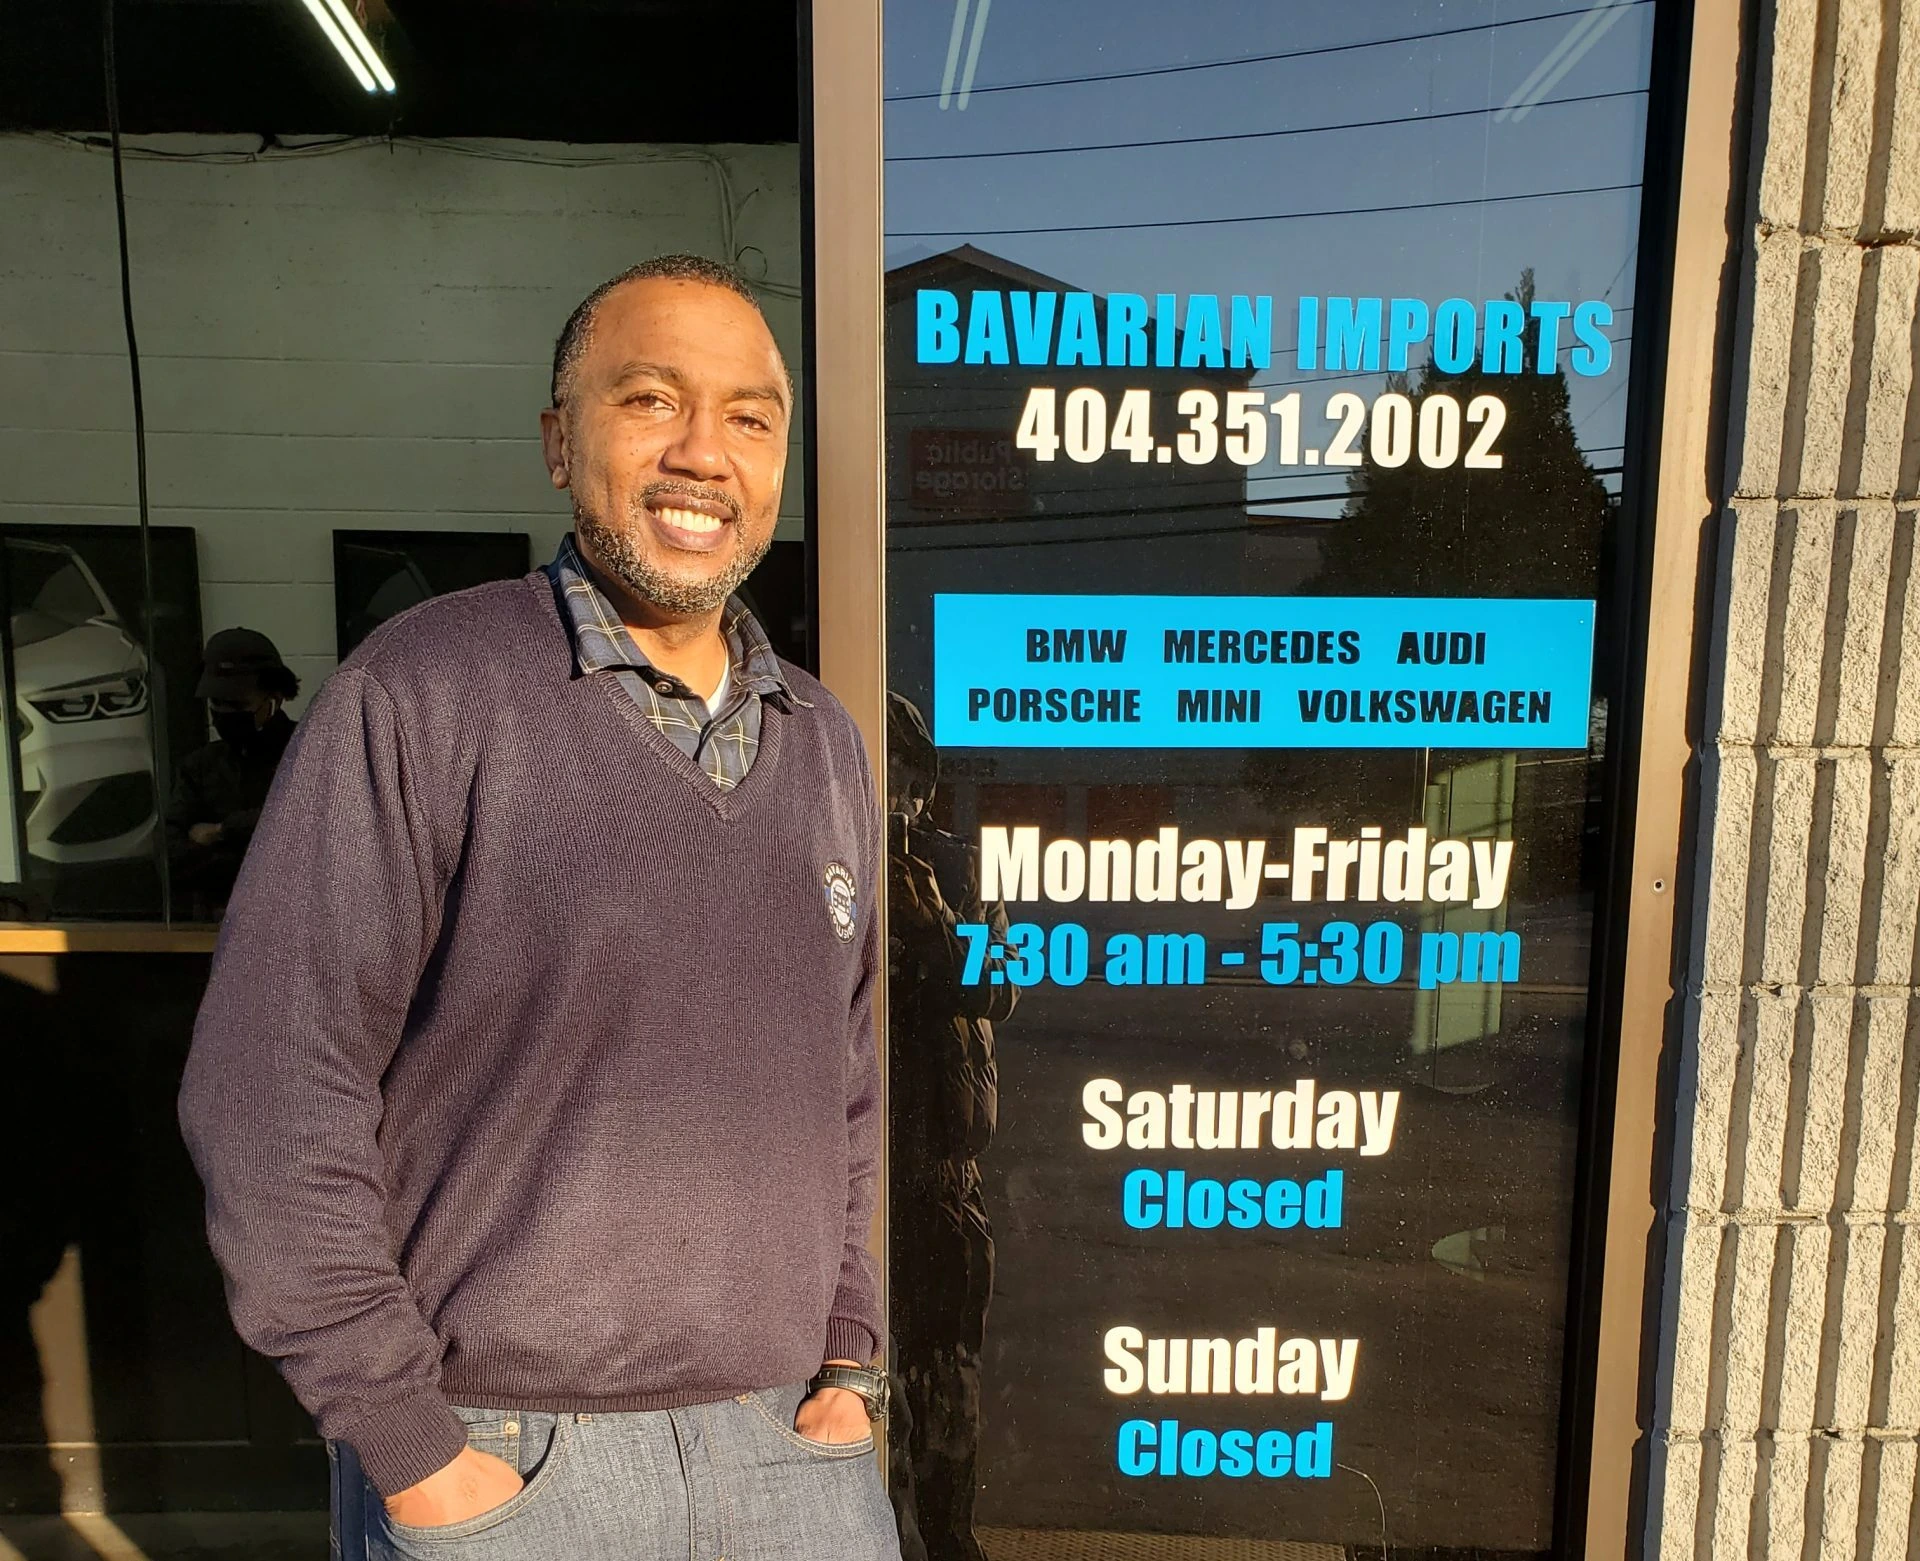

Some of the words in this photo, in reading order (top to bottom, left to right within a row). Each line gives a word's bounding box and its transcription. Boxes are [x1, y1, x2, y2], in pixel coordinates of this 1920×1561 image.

[916, 289, 1274, 371] BAVARIAN
[1296, 295, 1613, 378] IMPORTS
[1015, 387, 1507, 470] 404.351.2002
[1026, 628, 1127, 664] BMW
[1163, 629, 1361, 666] MERCEDES
[1396, 631, 1486, 666] AUDI
[968, 688, 1141, 723] PORSCHE
[1177, 689, 1261, 723] MINI
[1298, 689, 1551, 724] VOLKSWAGEN
[825, 865, 857, 897] BAVARIAN
[980, 826, 1515, 911] Monday-Friday
[956, 922, 1089, 987] 7:30
[1105, 933, 1207, 986] am
[1260, 921, 1404, 986] 5:30
[1418, 930, 1522, 991] pm
[1081, 1077, 1400, 1157] Saturday
[1122, 1167, 1345, 1231] Closed
[1102, 1326, 1360, 1402] Sunday
[1116, 1418, 1334, 1478] Closed
